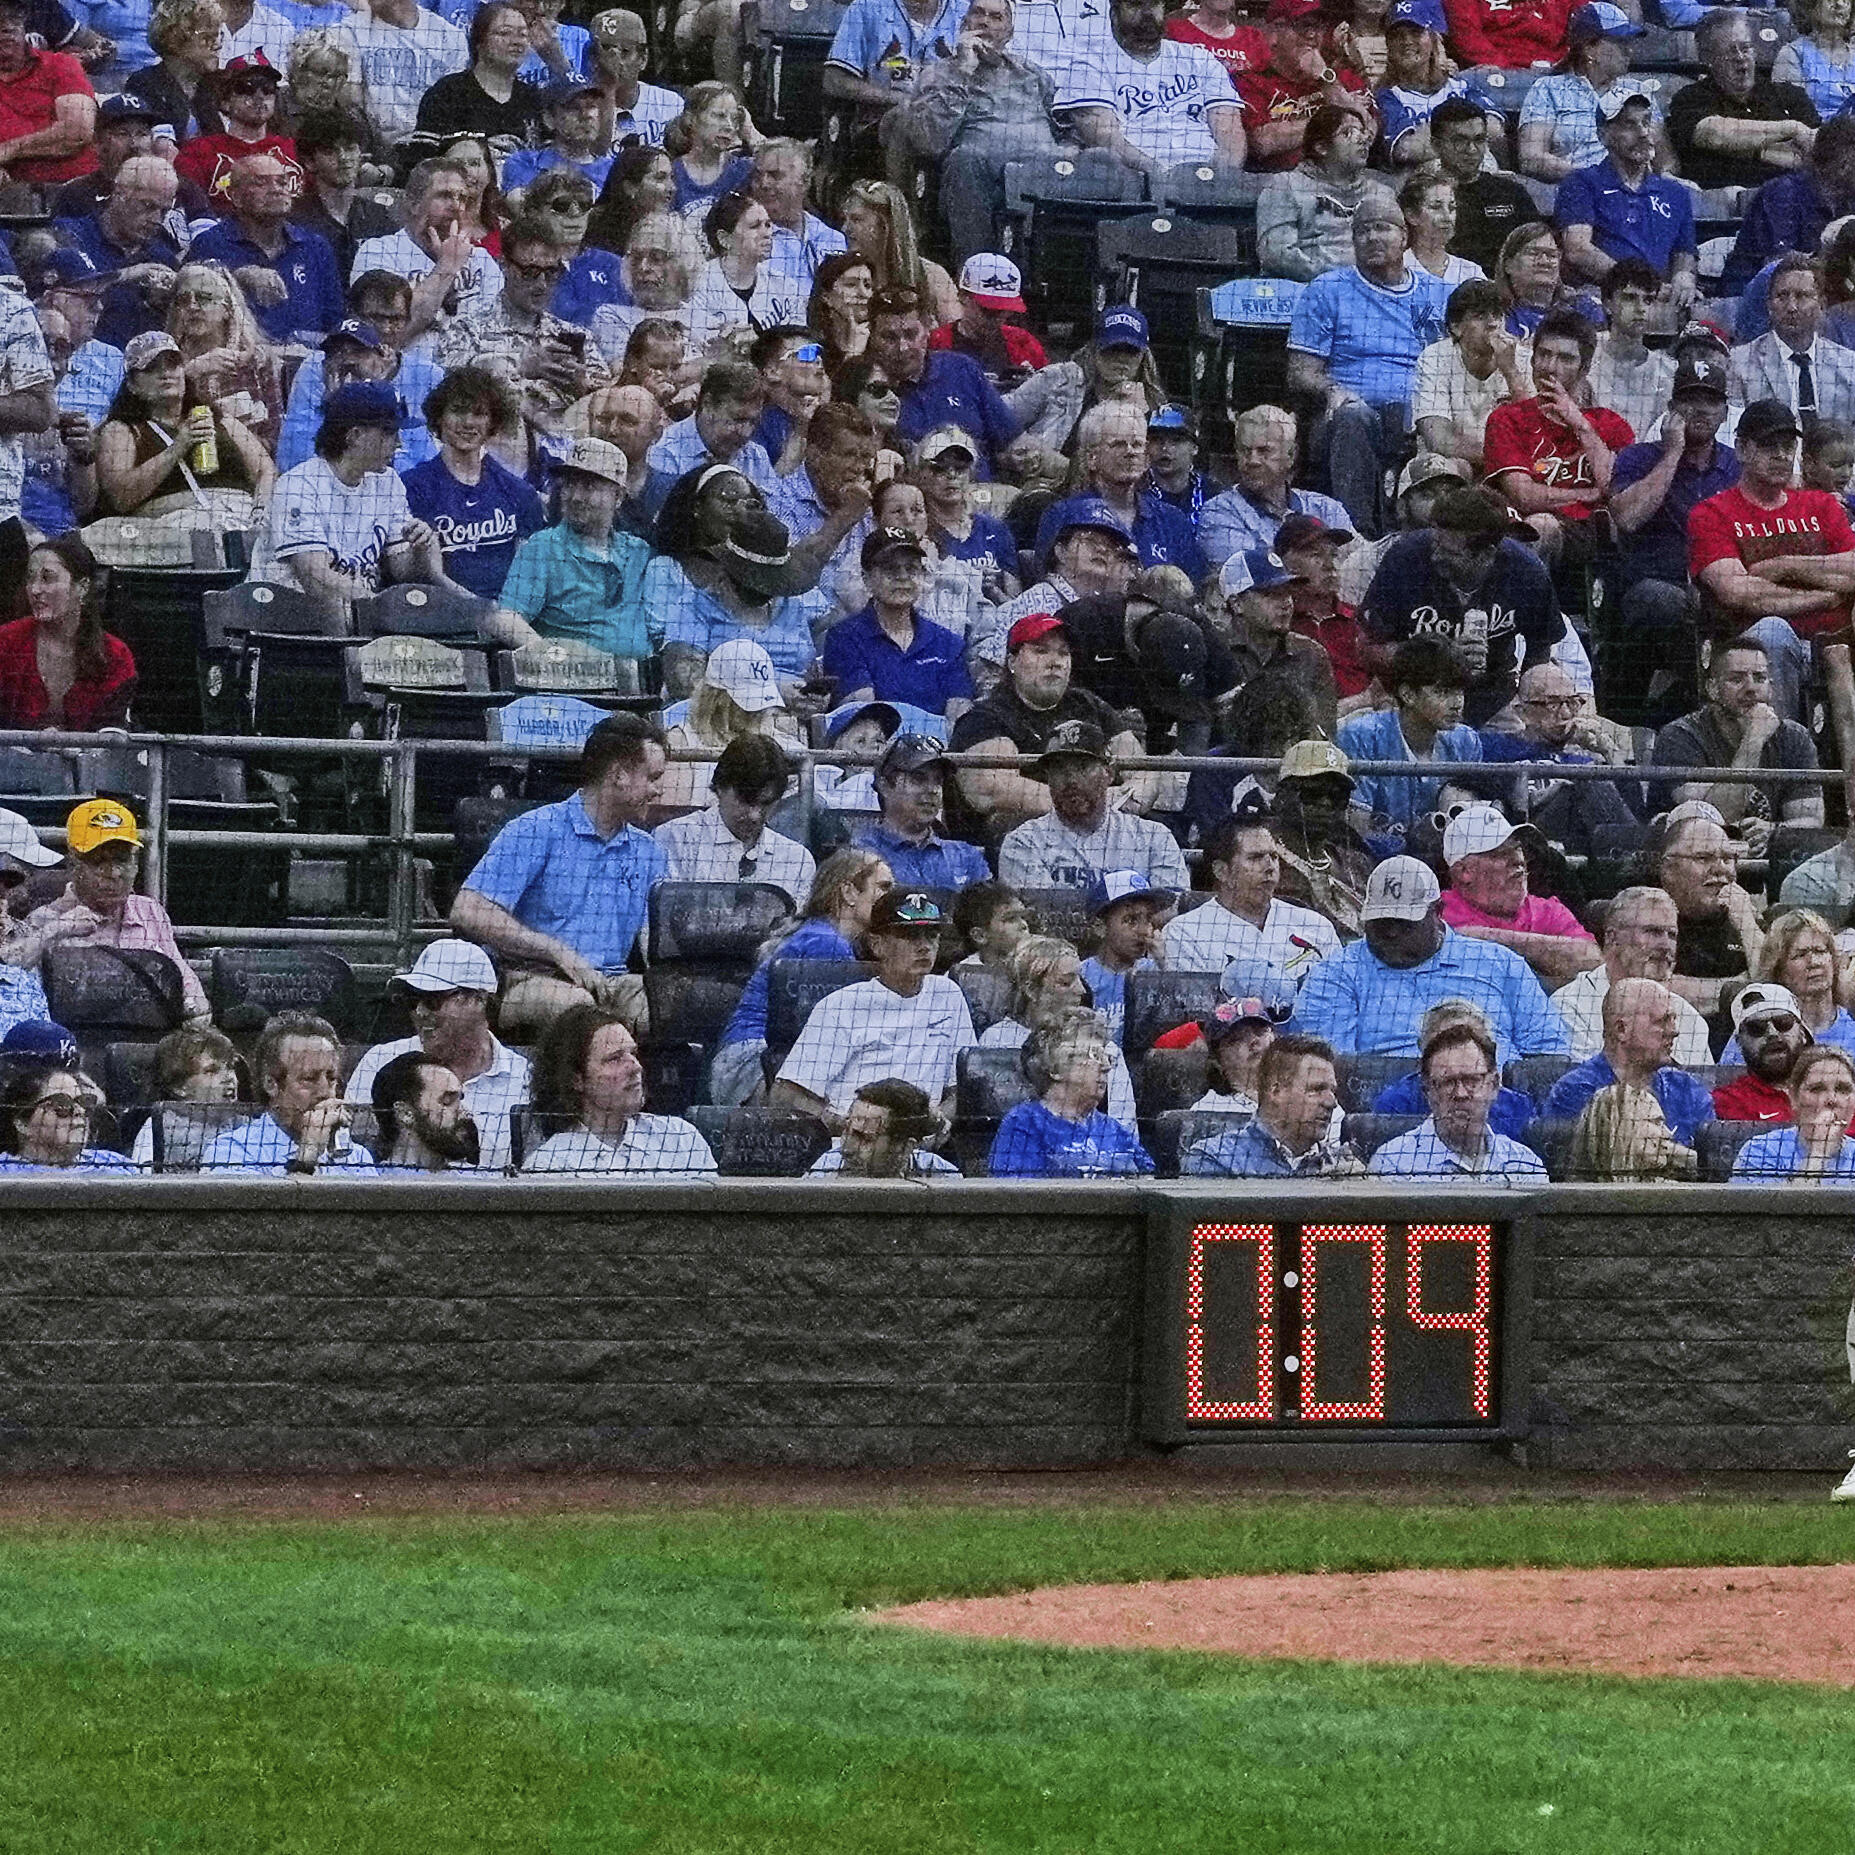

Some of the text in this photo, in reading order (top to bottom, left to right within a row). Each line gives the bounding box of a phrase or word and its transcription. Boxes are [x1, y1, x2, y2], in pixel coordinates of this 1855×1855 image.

[1397, 2, 1411, 13] KC
[1119, 74, 1199, 118] Royals
[1650, 196, 1671, 219] KC
[435, 513, 517, 553] Royals
[885, 527, 905, 539] KC
[1151, 544, 1167, 561] KC
[751, 662, 768, 681] KC
